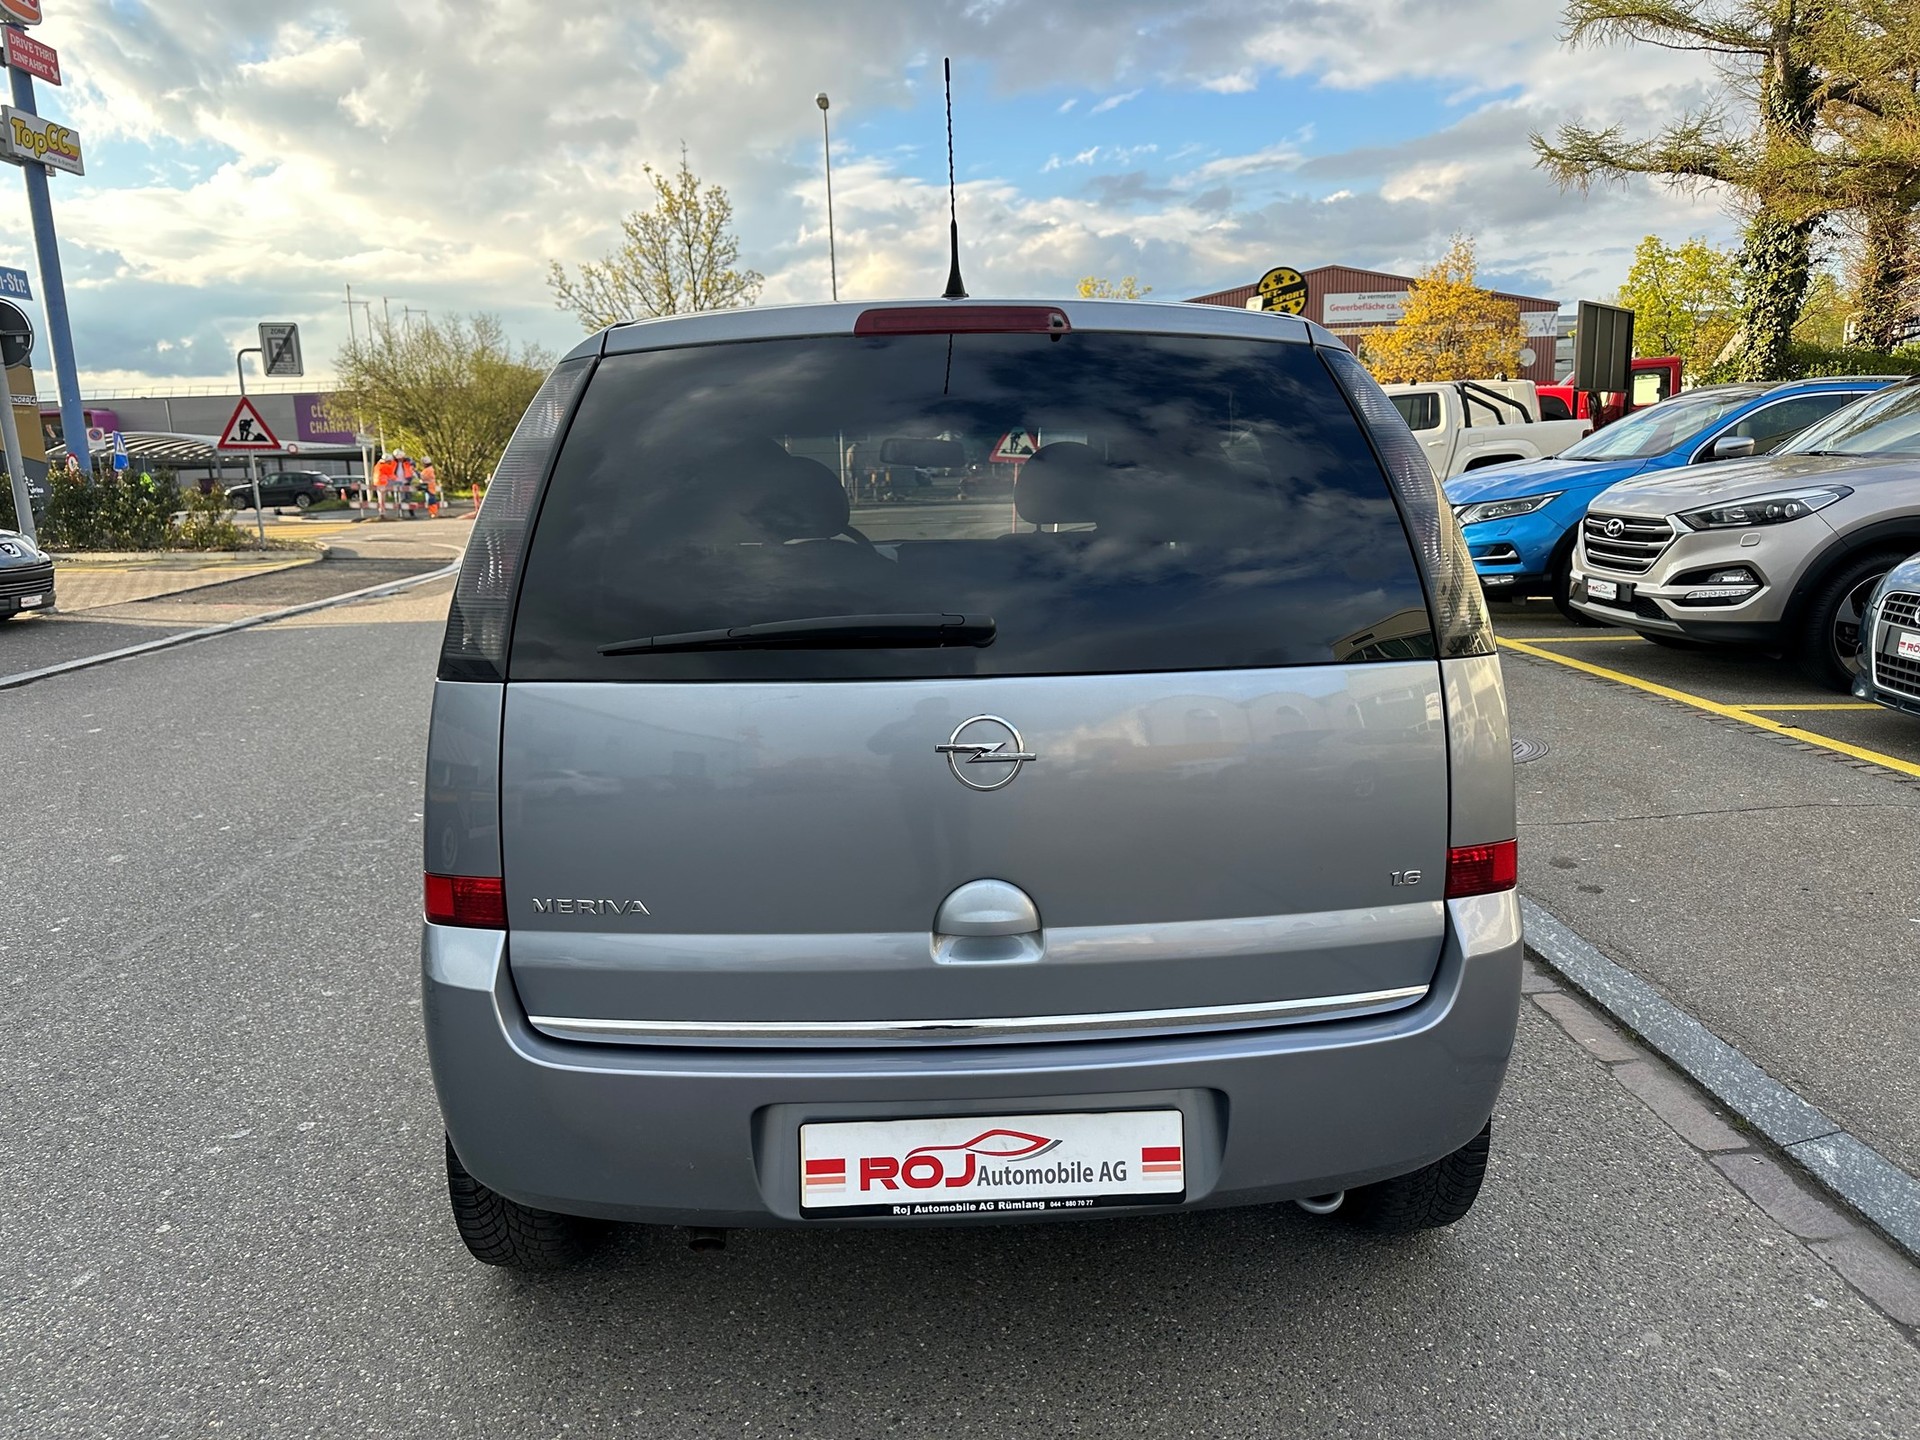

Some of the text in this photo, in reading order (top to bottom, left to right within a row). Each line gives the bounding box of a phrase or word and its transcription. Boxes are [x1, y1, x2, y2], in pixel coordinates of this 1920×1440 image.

[9, 33, 55, 63] DRIVE THRU
[12, 49, 49, 74] EINFAHRT
[10, 116, 70, 158] TopCC
[1272, 288, 1305, 304] SPORT
[1329, 303, 1385, 312] Gewerbefläche
[1907, 643, 1920, 652] RO
[531, 898, 651, 915] MERIVA
[859, 1153, 1128, 1191] ROJ Automobile AG
[893, 1206, 911, 1216] Roj
[914, 1201, 977, 1214] Automobile
[979, 1202, 995, 1211] AG
[999, 1200, 1046, 1211] Rümlang
